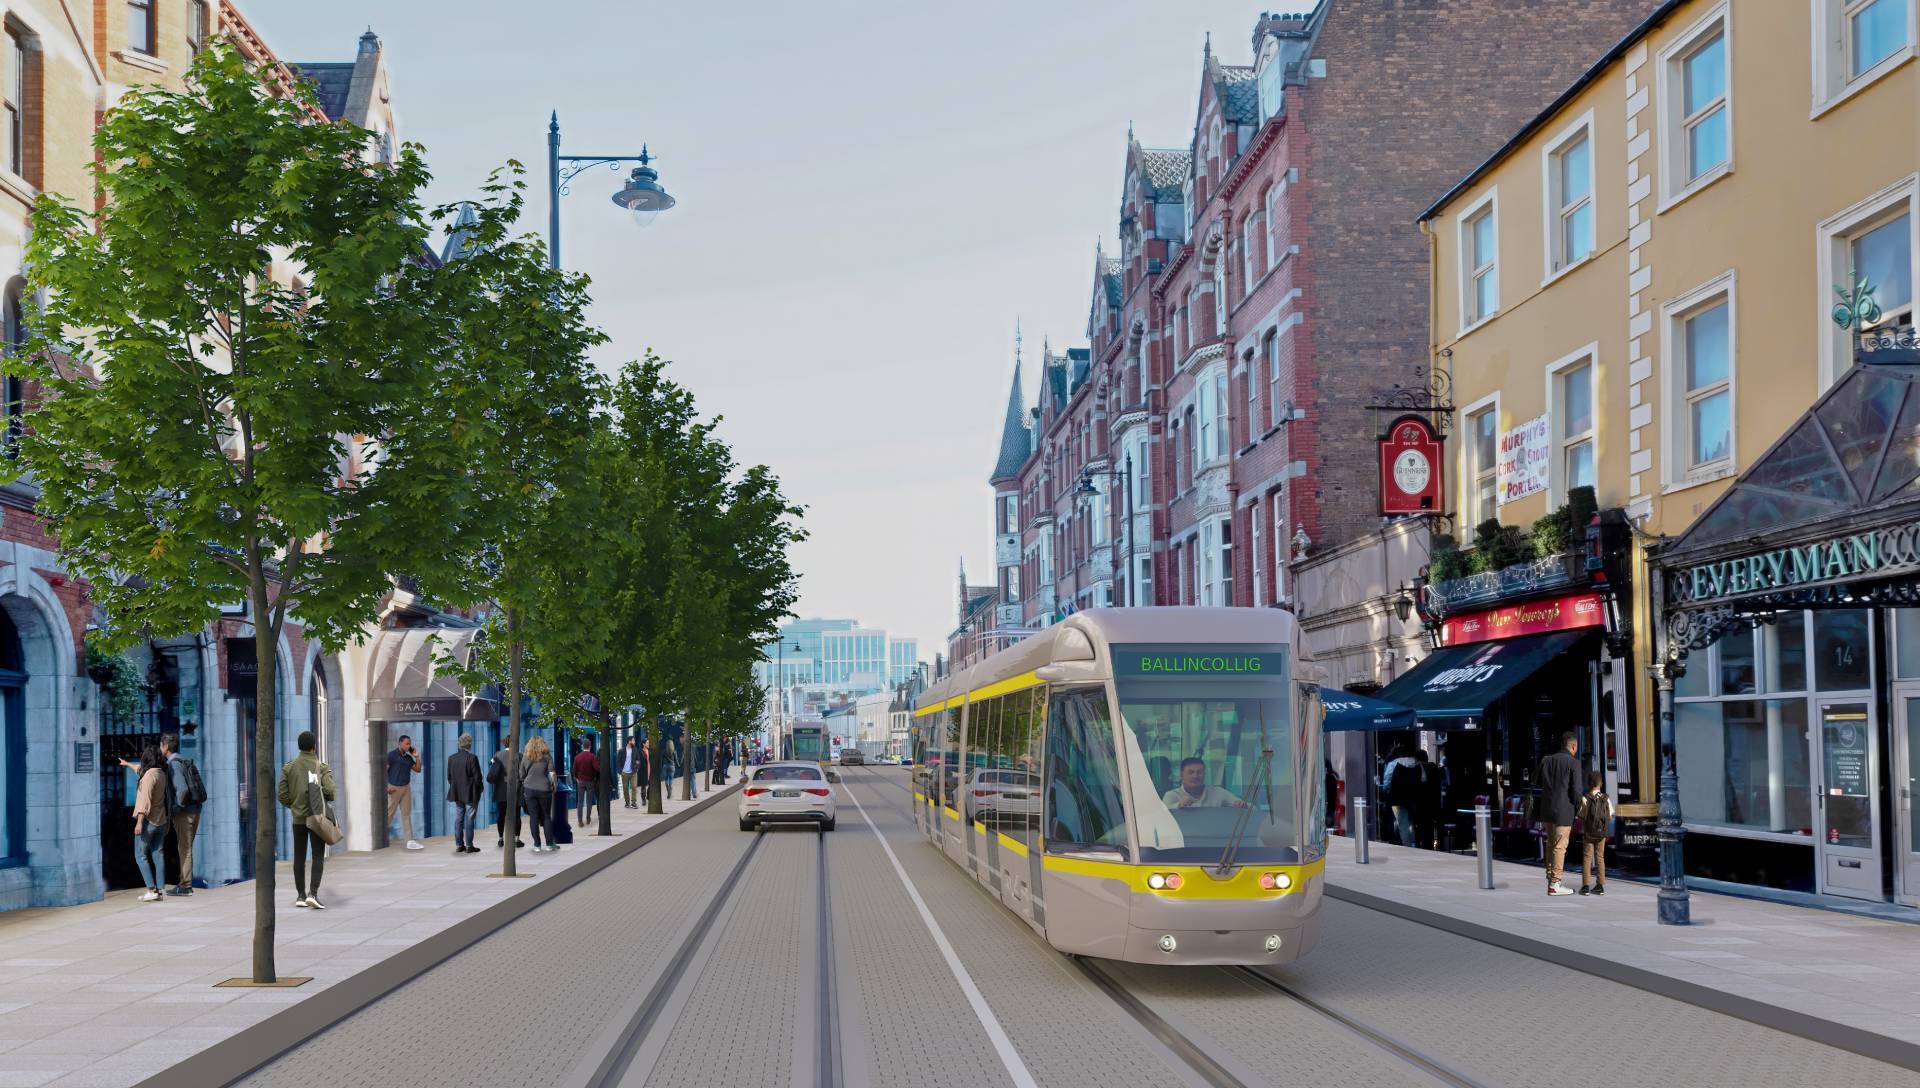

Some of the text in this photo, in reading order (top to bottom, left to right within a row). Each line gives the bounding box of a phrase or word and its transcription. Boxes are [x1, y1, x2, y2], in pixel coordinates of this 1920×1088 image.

[1691, 531, 1878, 600] EVERYMAN
[1140, 656, 1262, 673] BALLINCOLLIG
[1835, 646, 1853, 666] 14
[394, 702, 436, 712] ISAACS
